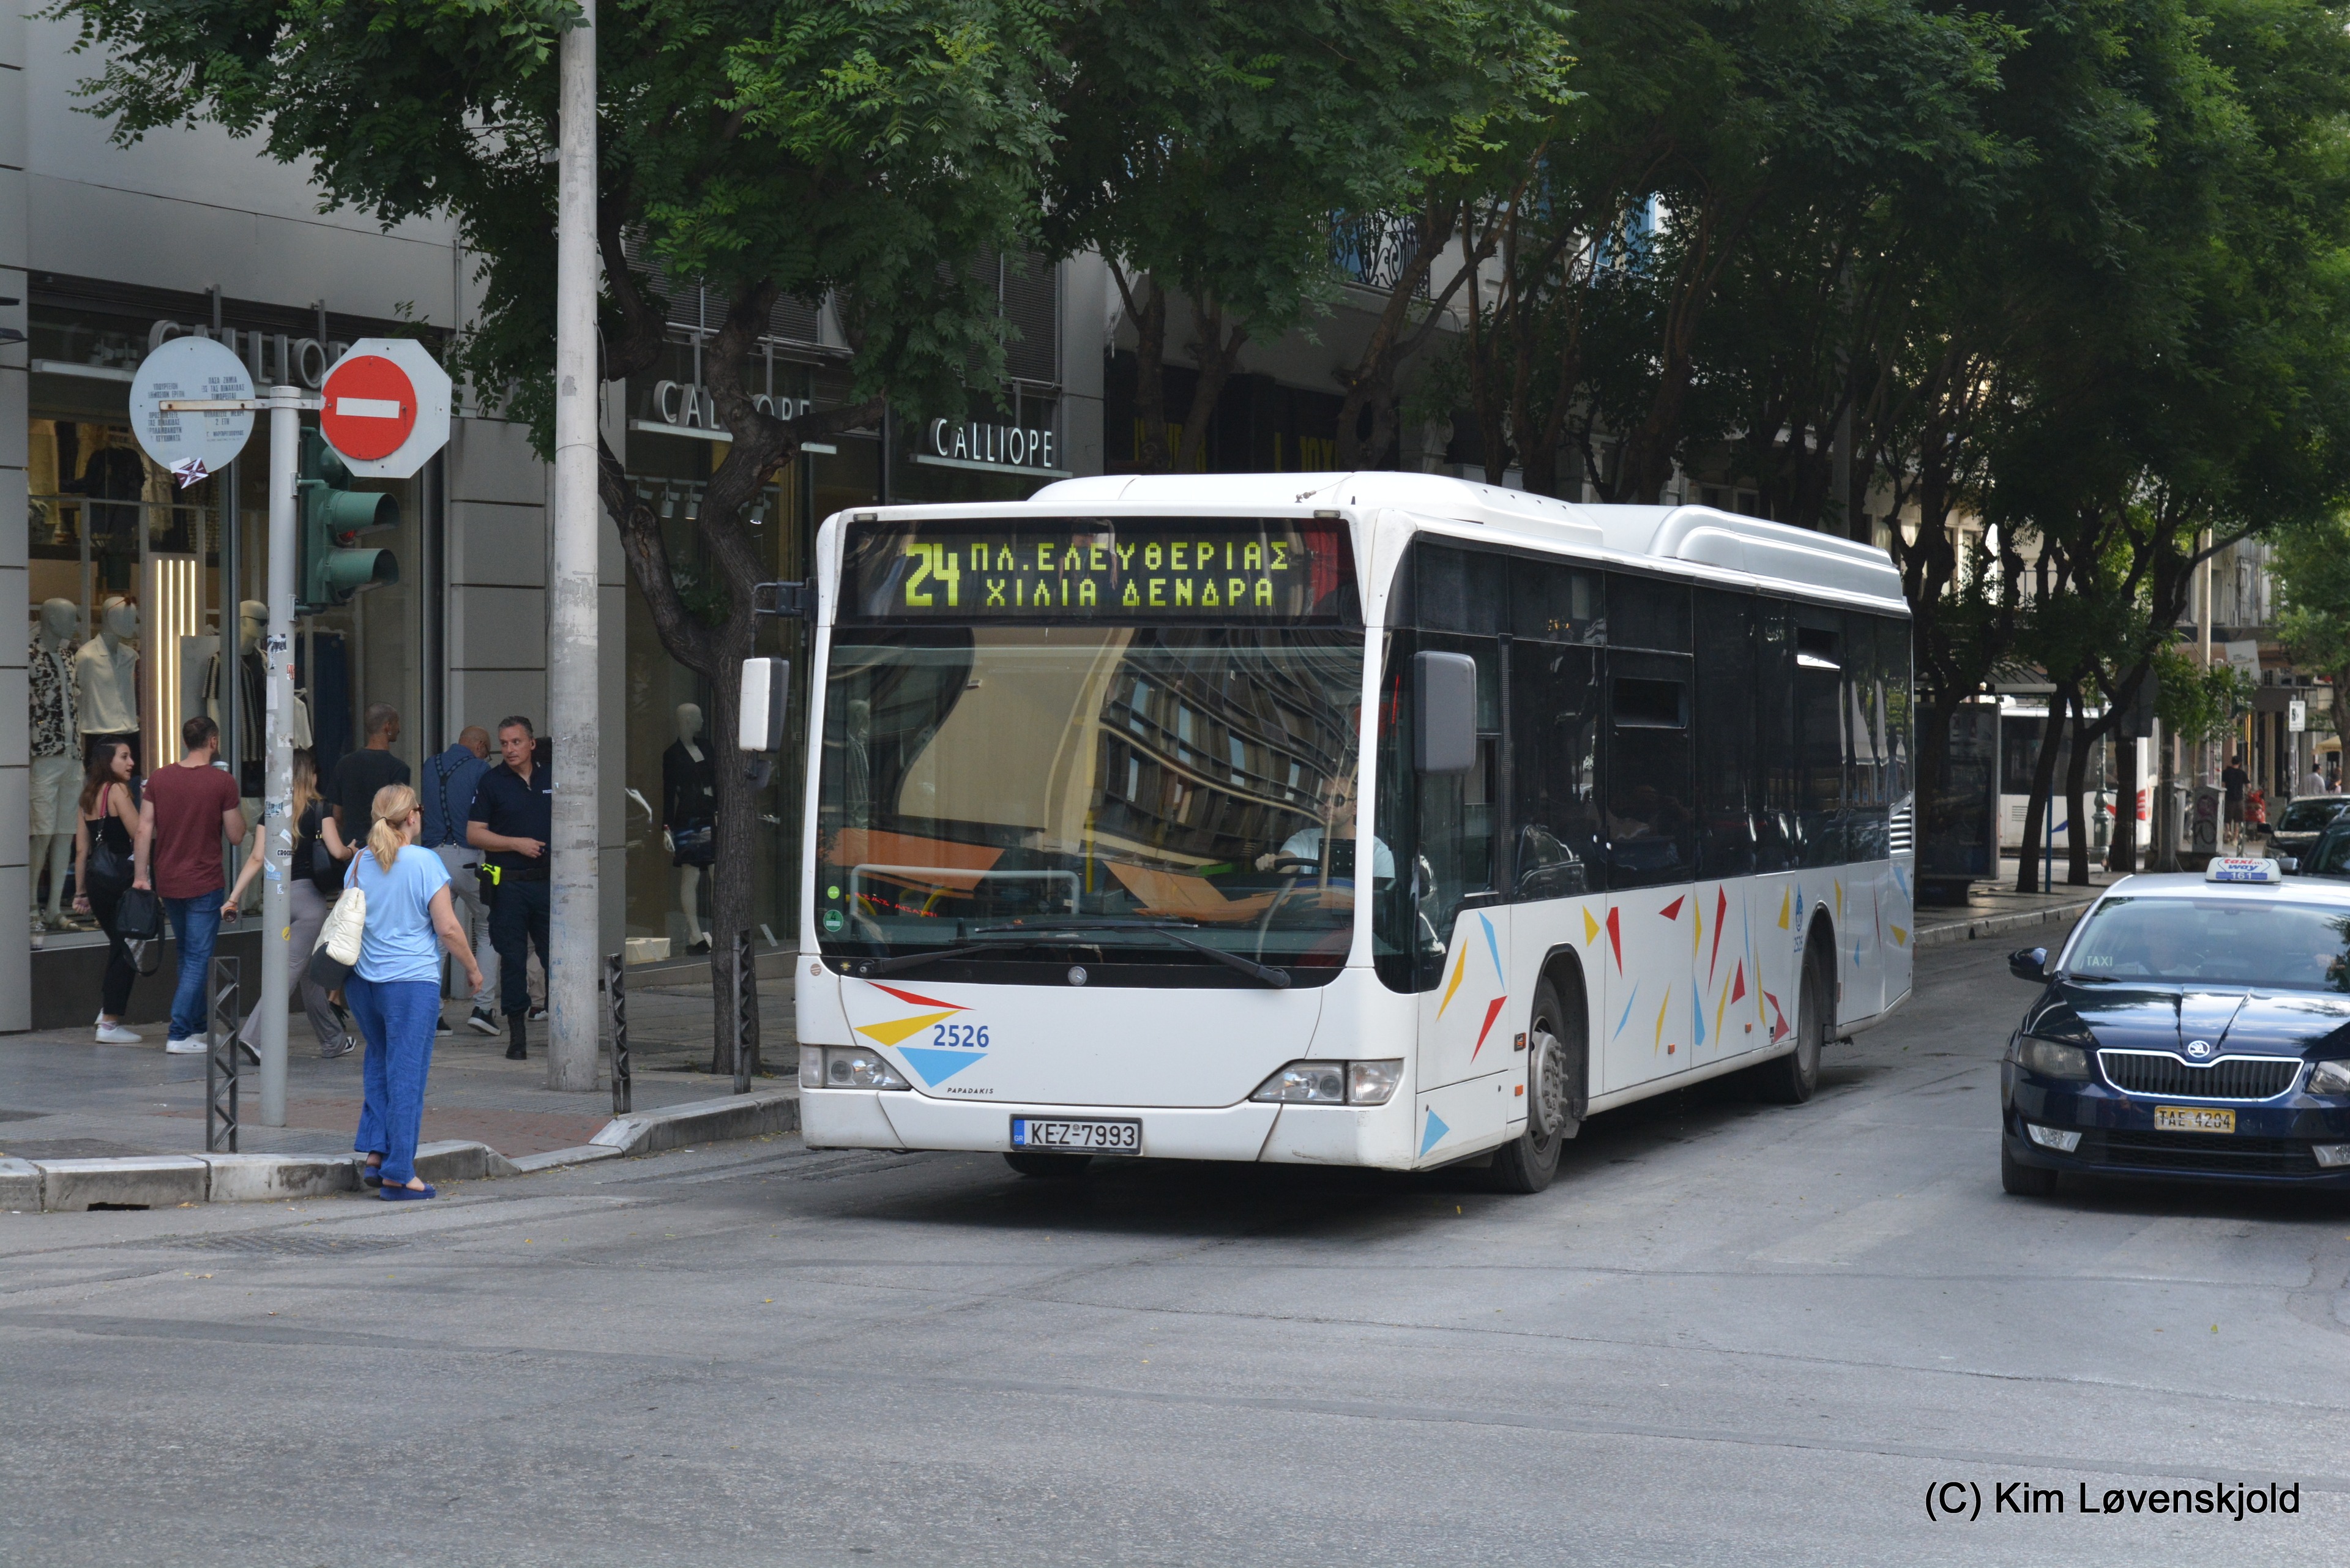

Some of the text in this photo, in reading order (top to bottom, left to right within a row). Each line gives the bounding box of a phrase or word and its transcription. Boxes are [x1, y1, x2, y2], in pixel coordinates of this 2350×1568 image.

[930, 417, 1053, 468] CALLIOPE
[906, 543, 960, 608] 24
[986, 577, 1274, 607] ΧΙΛΙΑ ΔΕΝΔΡΑ
[2086, 955, 2113, 966] TAXI
[933, 1024, 990, 1048] 2526
[1031, 1122, 1135, 1147] KEZ-7993
